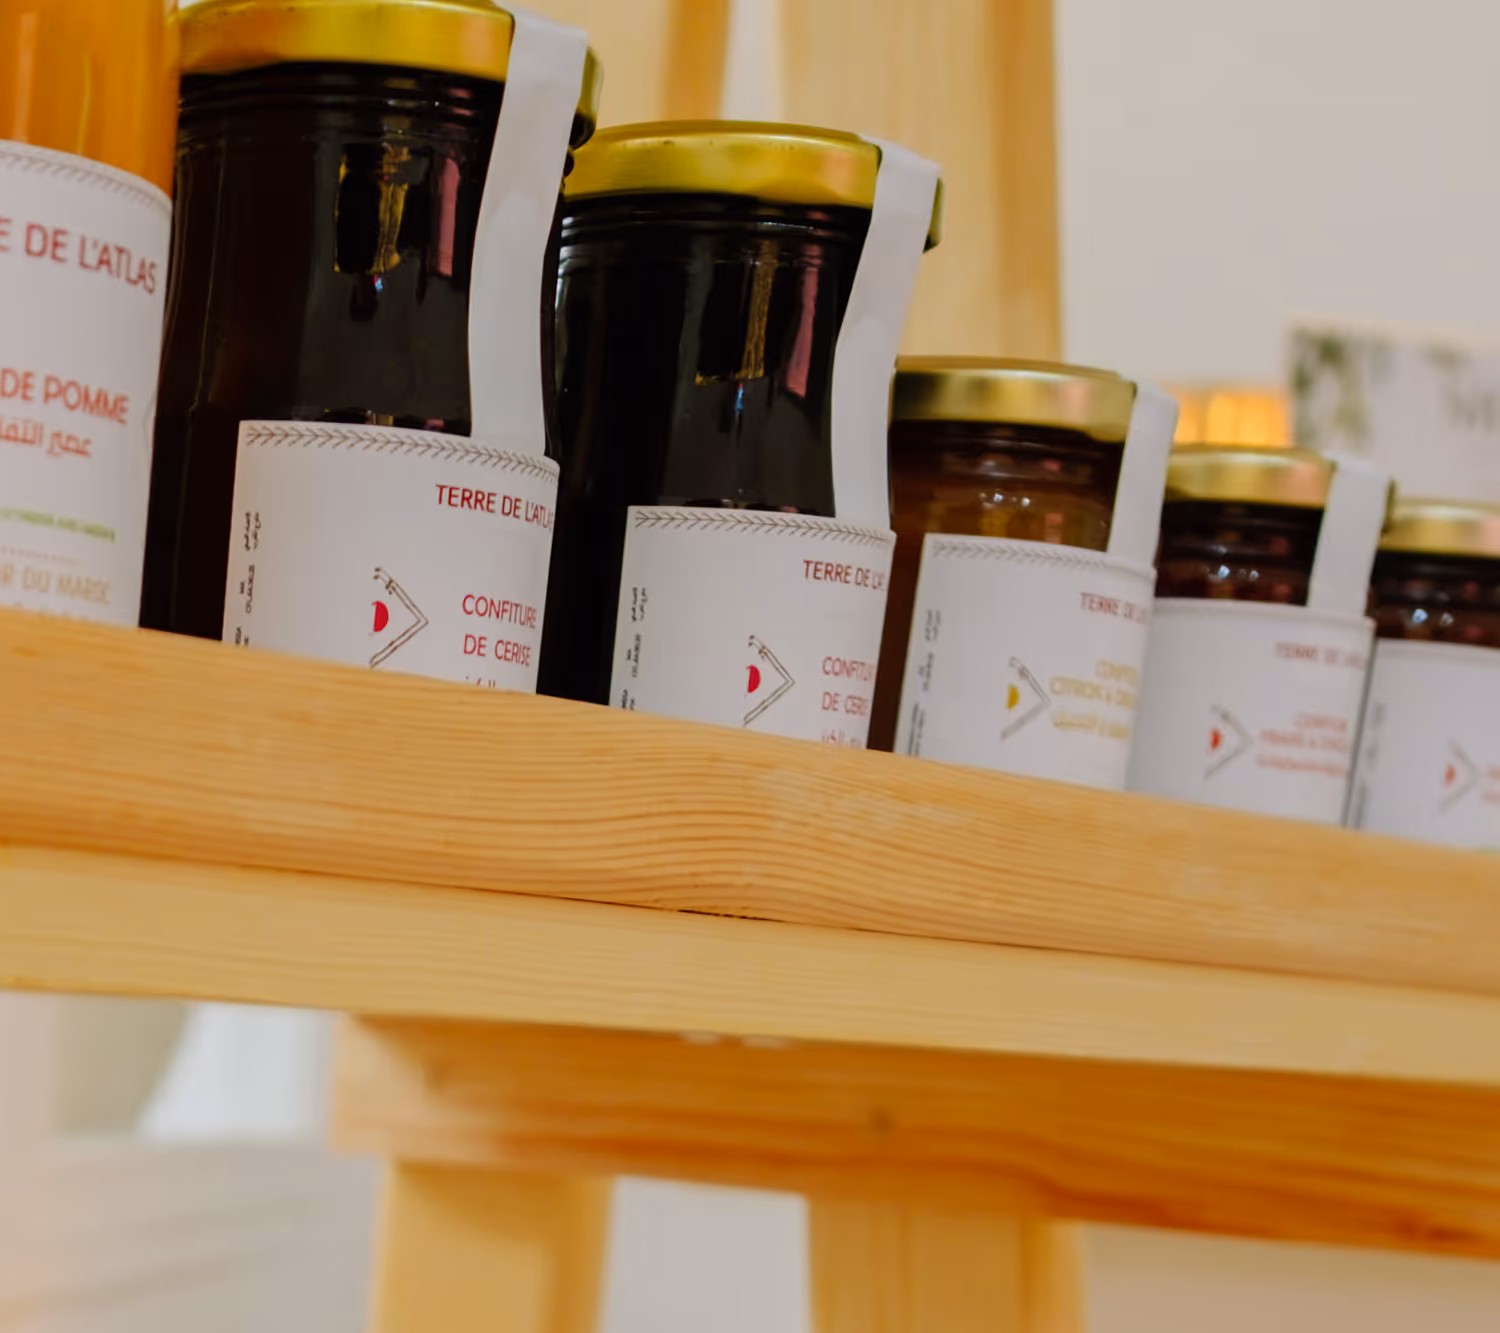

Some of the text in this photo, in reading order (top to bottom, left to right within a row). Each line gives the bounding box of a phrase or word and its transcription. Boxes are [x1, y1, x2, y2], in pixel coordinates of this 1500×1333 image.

[25, 221, 69, 264] DE
[78, 234, 158, 296] L'ATLAS
[0, 366, 35, 402] DE
[43, 373, 131, 425] POMME
[434, 482, 497, 514] TERRE
[501, 494, 522, 520] DE
[21, 565, 52, 594] DU
[803, 559, 852, 584] TERRE
[855, 567, 871, 588] DE
[462, 593, 537, 630] CONFITURE
[463, 634, 531, 668] DE CERISE
[821, 690, 841, 713] DE
